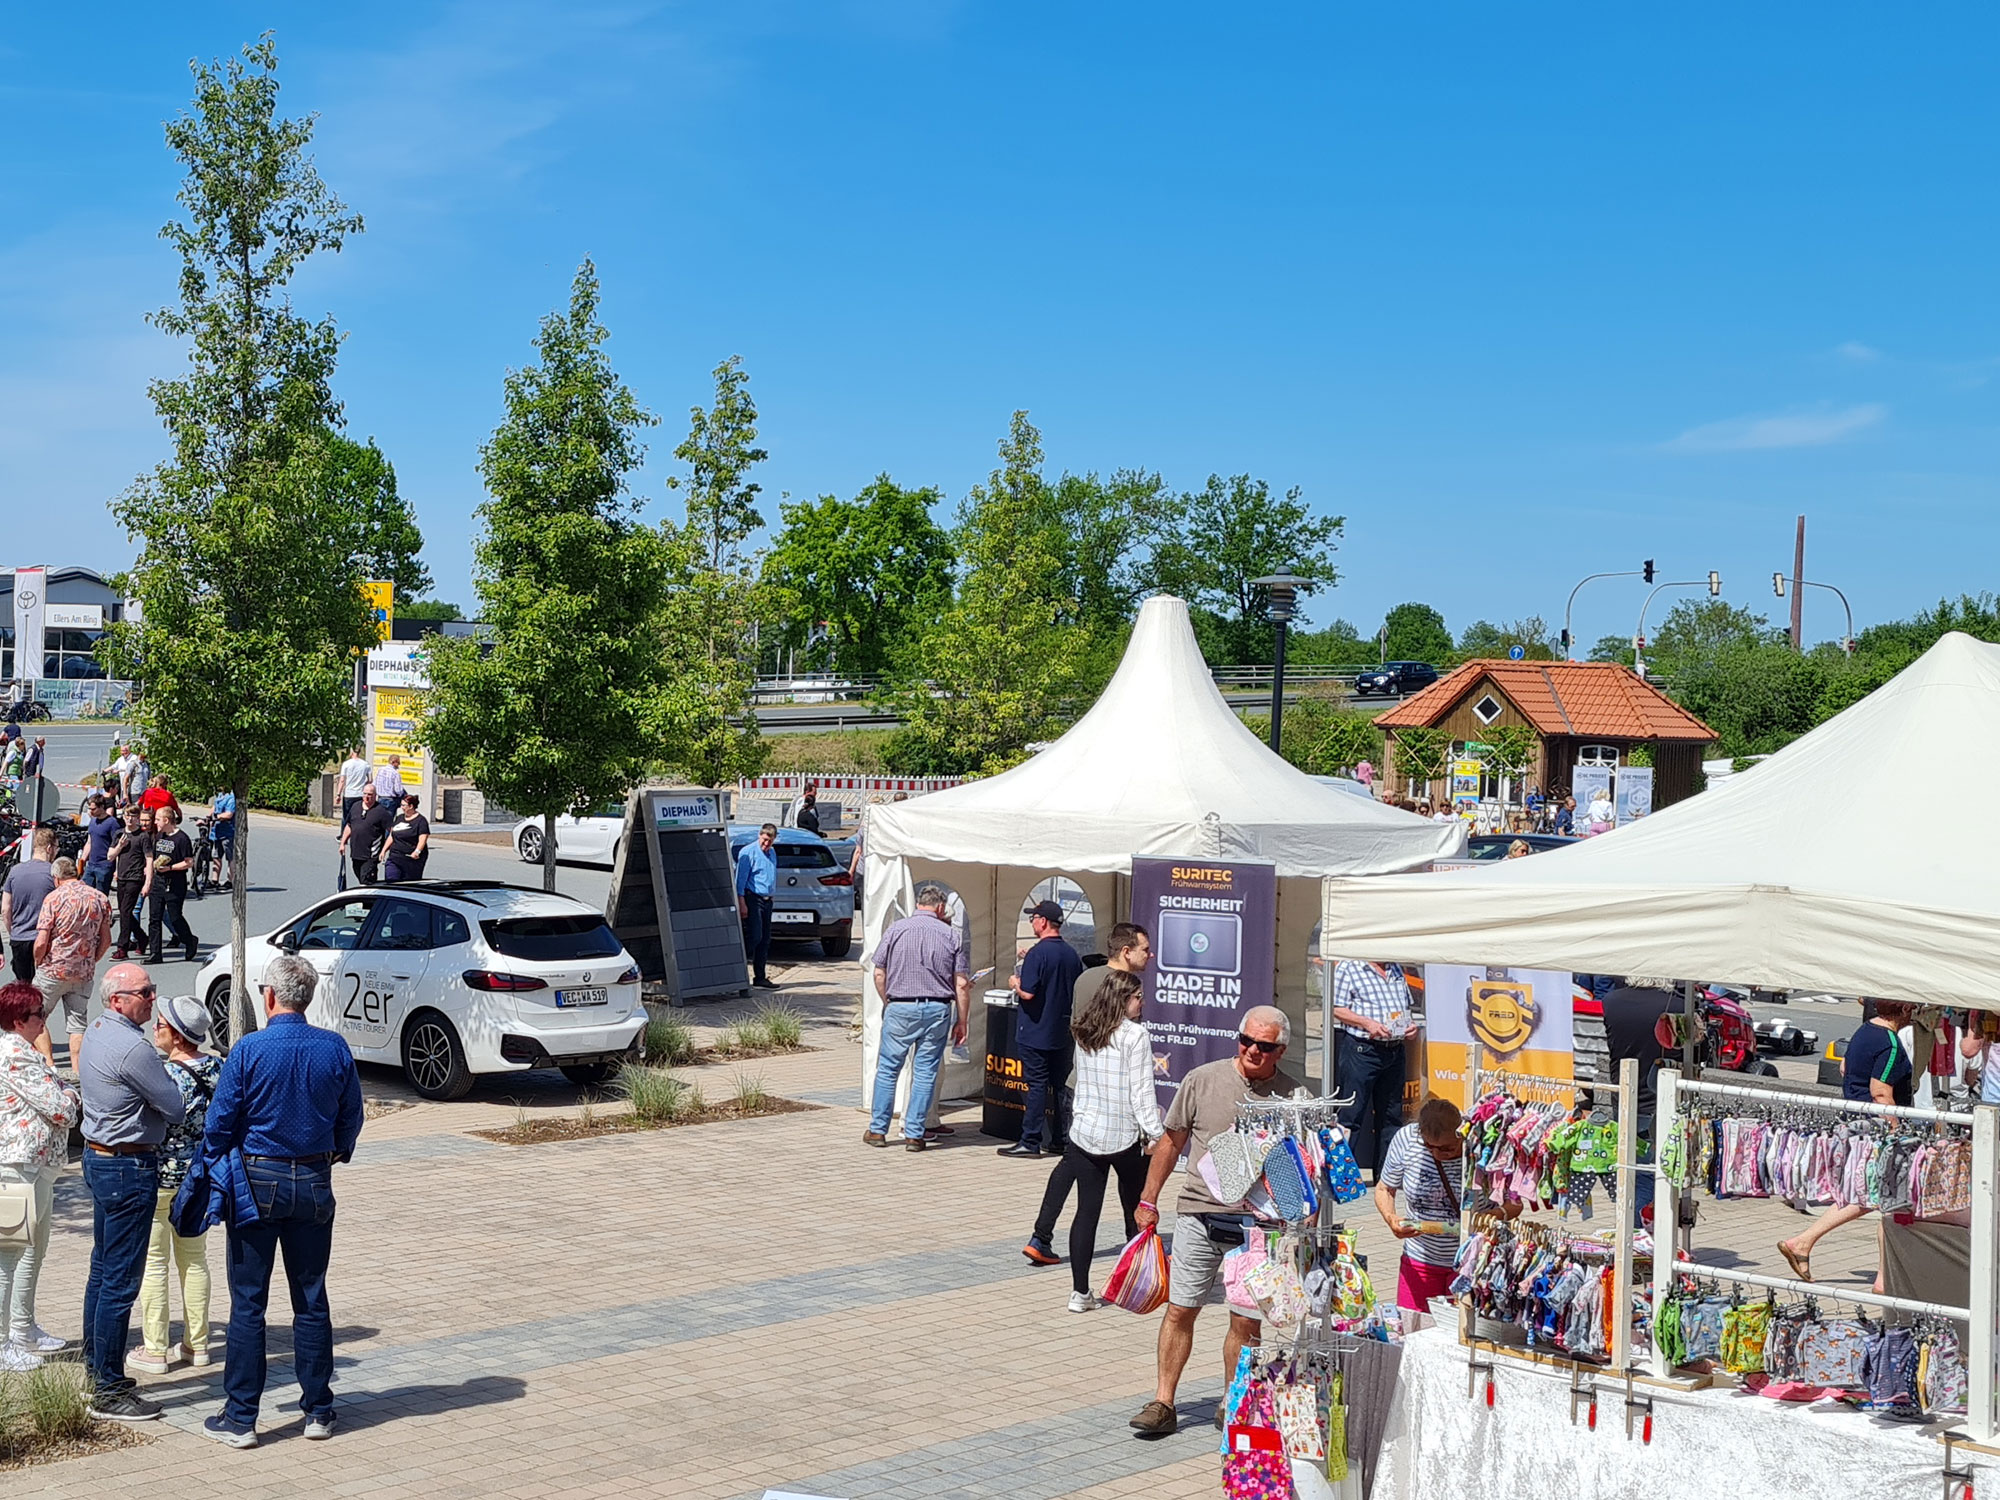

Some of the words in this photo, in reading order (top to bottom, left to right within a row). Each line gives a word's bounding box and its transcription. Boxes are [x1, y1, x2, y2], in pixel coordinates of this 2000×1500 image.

[369, 660, 417, 672] DIEPHAUS
[661, 805, 708, 818] DIEPHAUS
[1171, 867, 1233, 882] SURITEC
[1170, 880, 1233, 890] Frühwarnsystem
[1159, 895, 1244, 912] SICHERHEIT
[365, 970, 378, 980] DER
[380, 981, 395, 991] BMW
[1156, 972, 1215, 992] MADE
[1220, 977, 1241, 995] IN
[343, 972, 394, 1025] 2er
[562, 991, 576, 1004] VEC
[592, 989, 606, 1001] 519
[1155, 989, 1241, 1010] GERMANY
[363, 1023, 387, 1035] TOURER
[1178, 1023, 1240, 1040] Frühwarnsy
[1167, 1034, 1198, 1046] FR.ED
[986, 1053, 1023, 1078] SURI
[985, 1072, 1030, 1092] Frühwarns
[1434, 1068, 1459, 1081] Wie
